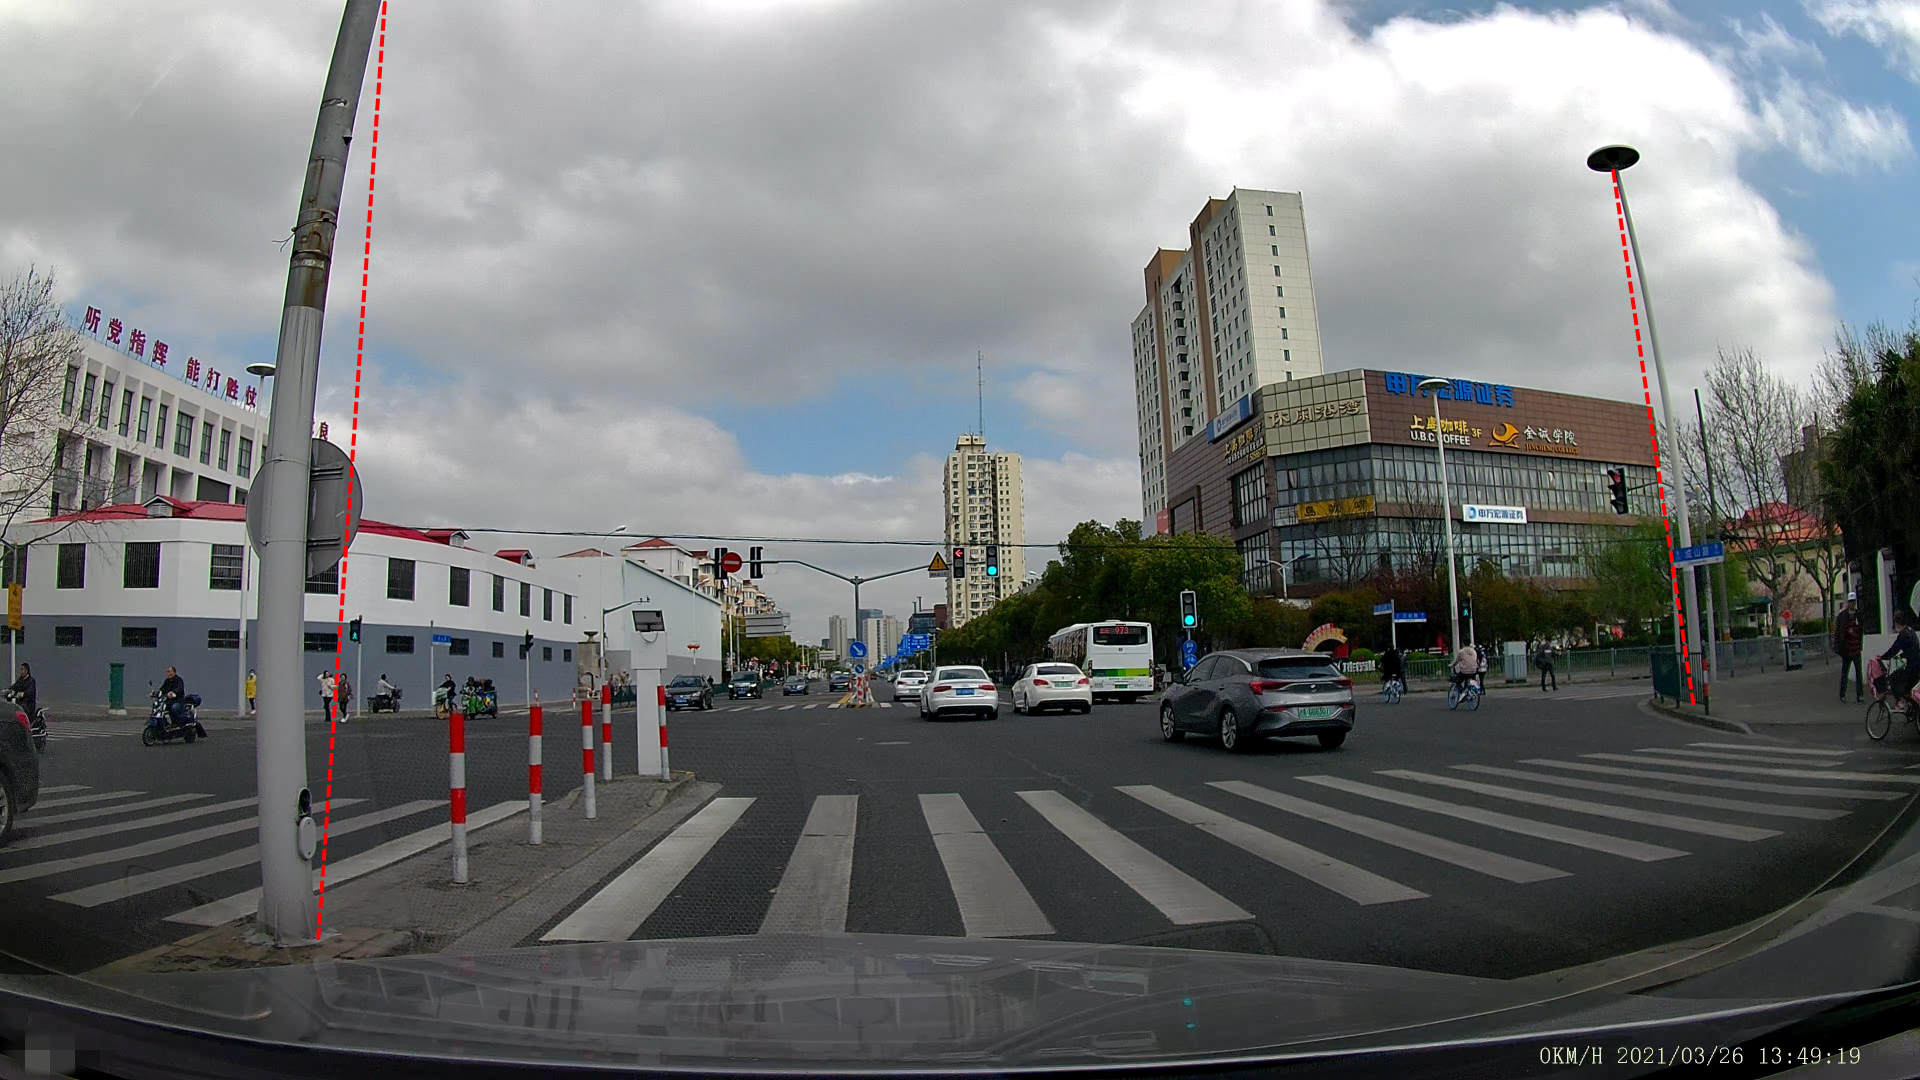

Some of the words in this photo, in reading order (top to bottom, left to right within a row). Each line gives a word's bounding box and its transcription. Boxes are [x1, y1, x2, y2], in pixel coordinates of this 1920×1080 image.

[84, 305, 170, 364] 听党指挥
[186, 356, 258, 409] 能打胜仗
[1267, 400, 1362, 428] 休闲港湾
[1410, 414, 1469, 434] 上岛咖啡
[1471, 427, 1482, 438] 3F
[1410, 430, 1435, 442] U.B.C
[1437, 433, 1471, 446] OFFEE
